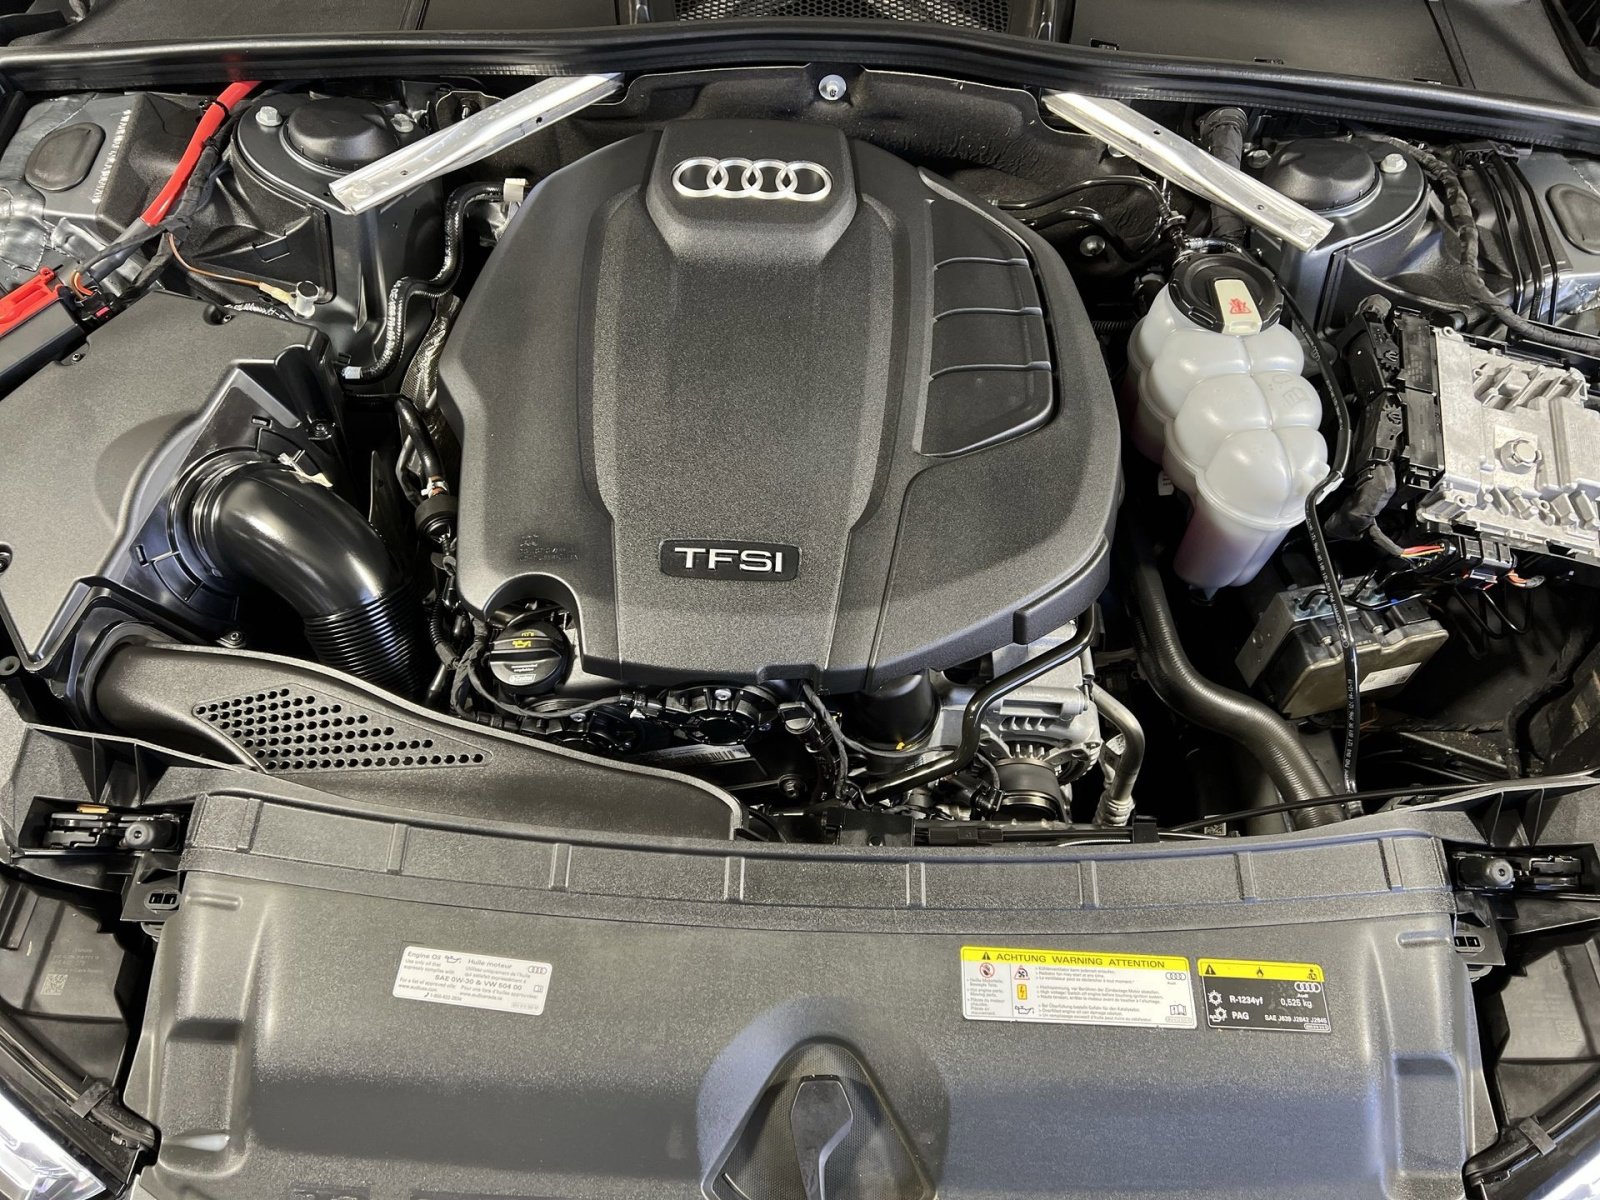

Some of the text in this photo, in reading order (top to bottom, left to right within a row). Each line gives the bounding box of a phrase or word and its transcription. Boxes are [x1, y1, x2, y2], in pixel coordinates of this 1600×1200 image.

[675, 547, 782, 573] TFSI
[486, 961, 513, 969] moteur
[996, 953, 1165, 968] ACHTUNG WARNING ATTENTION
[1303, 999, 1313, 1009] kg
[1231, 1011, 1249, 1020] PAG
